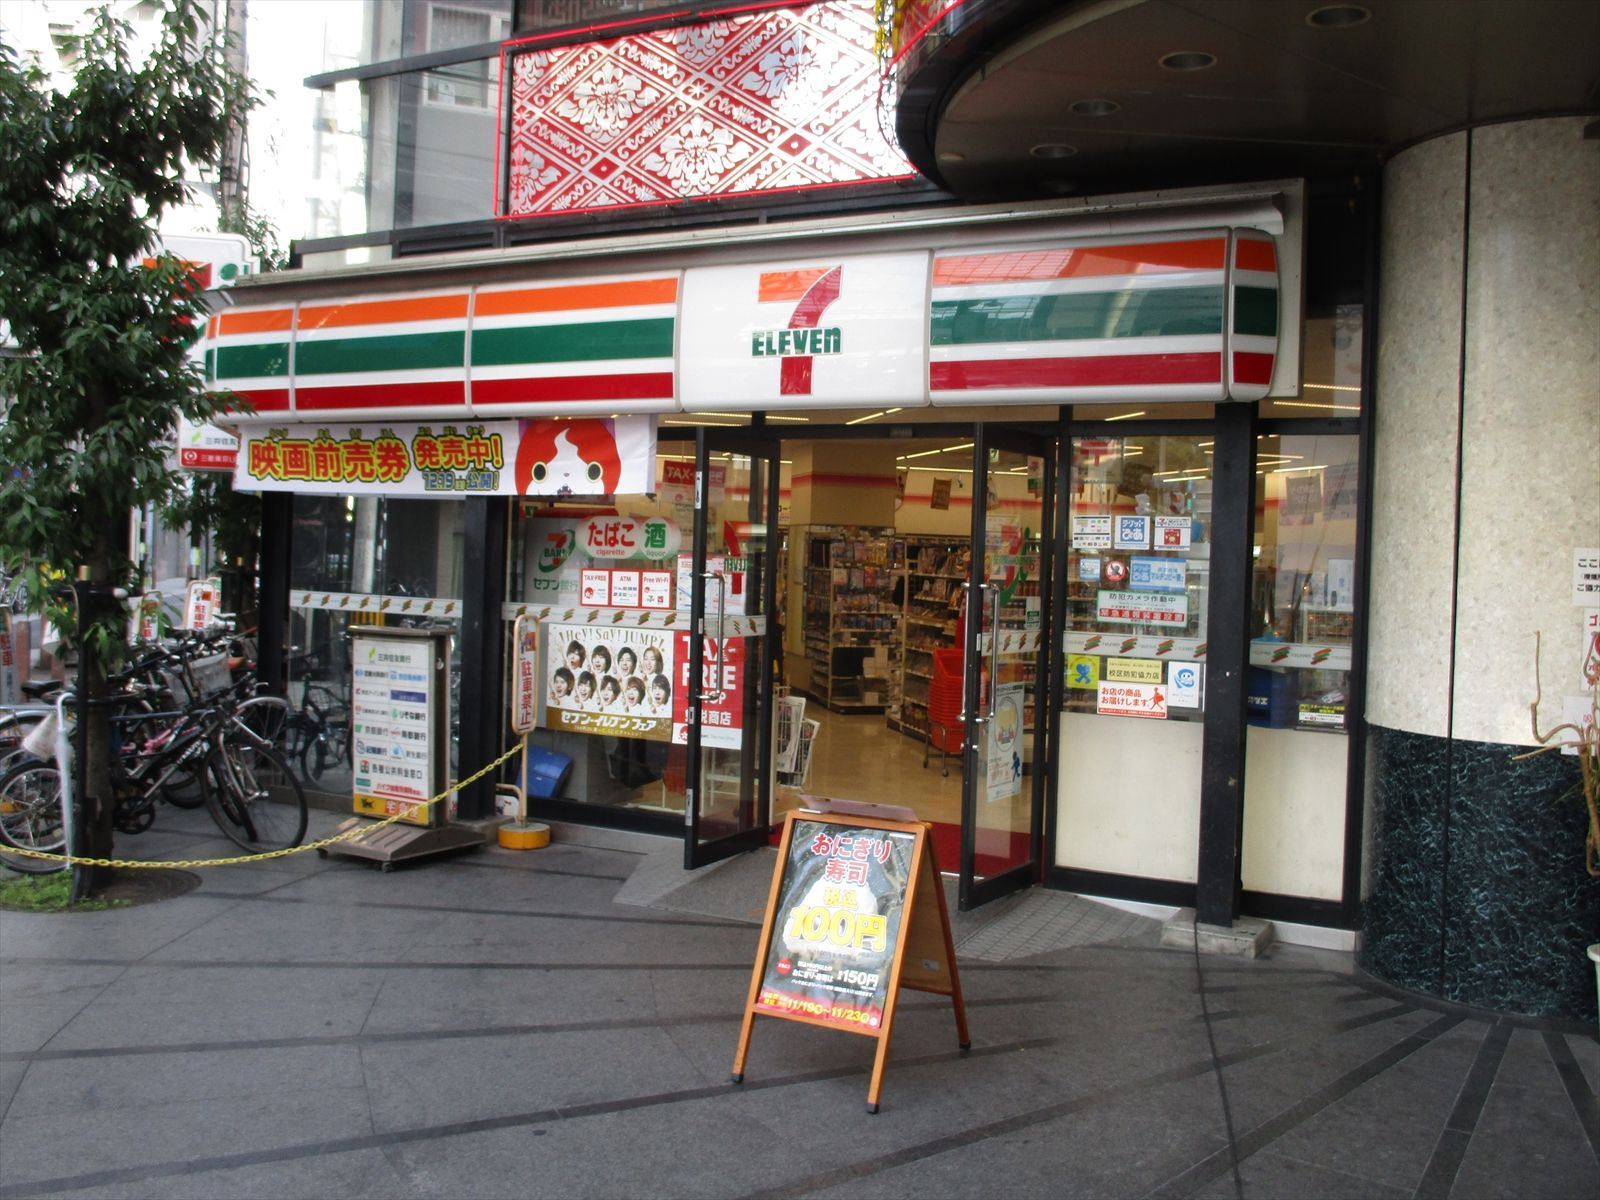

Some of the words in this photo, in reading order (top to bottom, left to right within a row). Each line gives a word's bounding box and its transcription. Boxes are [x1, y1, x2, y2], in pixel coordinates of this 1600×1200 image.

[249, 437, 411, 483] 映画前売券
[412, 433, 504, 471] 発売中!
[588, 521, 635, 548] たばこ
[644, 522, 666, 549] 酒
[1108, 592, 1177, 604] 防犯カメラ作動中
[377, 653, 412, 664] 三井住友銀行
[1109, 669, 1160, 680] 校区防犯協力店
[1101, 687, 1142, 698] お店の商品
[811, 833, 892, 864] おにぎり
[825, 858, 869, 887] 寿司
[790, 904, 887, 952] 100円
